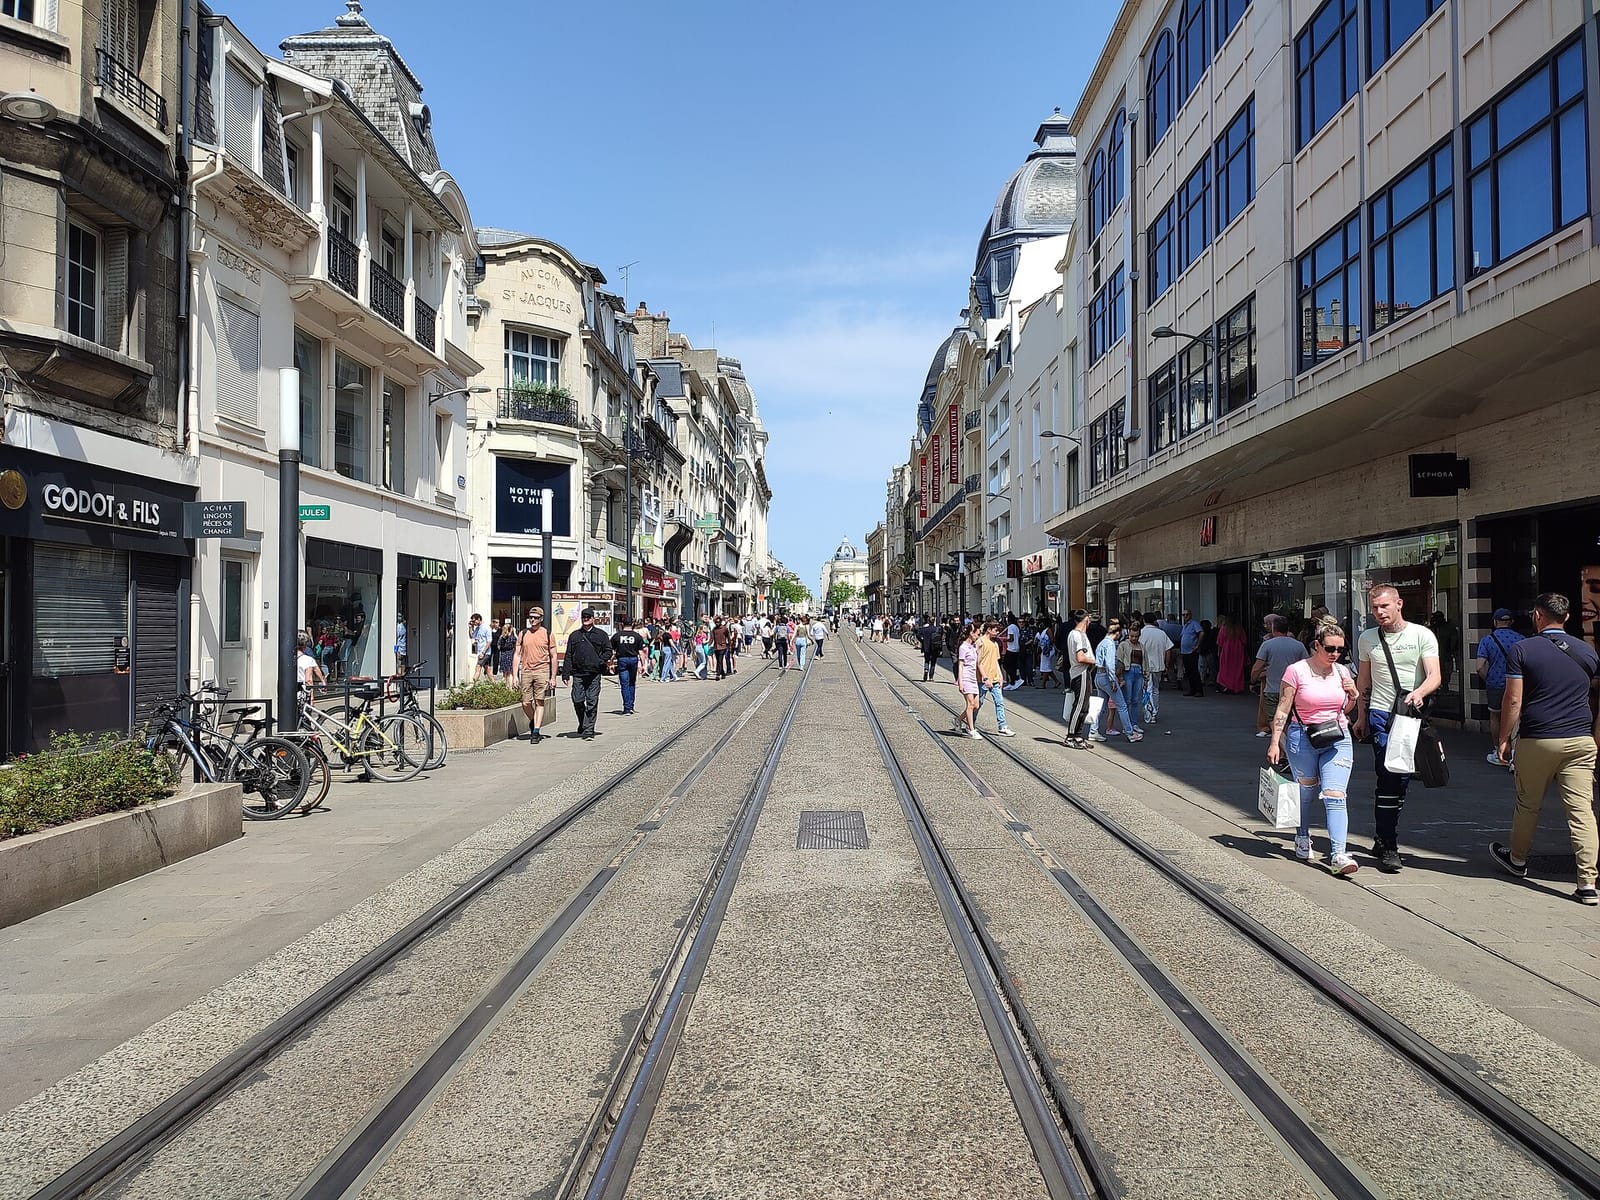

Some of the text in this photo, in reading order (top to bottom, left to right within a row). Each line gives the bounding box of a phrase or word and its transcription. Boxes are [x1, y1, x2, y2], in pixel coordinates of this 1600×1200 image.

[521, 268, 561, 290] AU COIN
[520, 292, 572, 314] JACQUES
[1417, 471, 1454, 479] SEPHORA
[509, 487, 554, 498] NOTHI
[43, 484, 160, 526] GODOT & FILS
[511, 496, 525, 504] TO
[300, 508, 325, 517] JULES
[418, 558, 449, 582] JULES
[516, 561, 544, 574] undi
